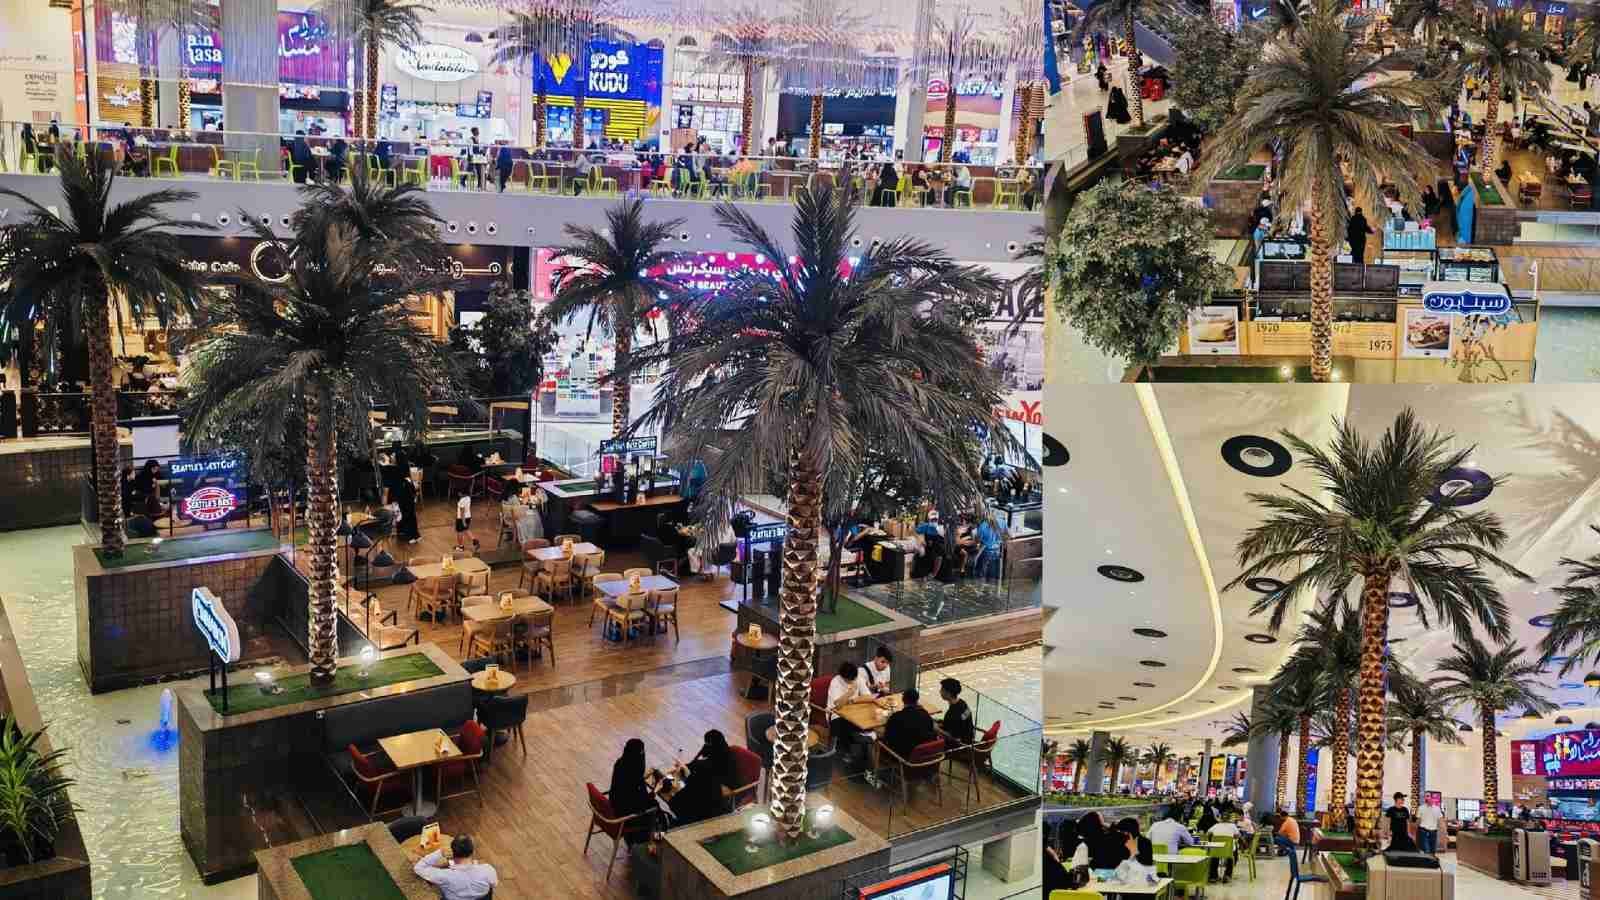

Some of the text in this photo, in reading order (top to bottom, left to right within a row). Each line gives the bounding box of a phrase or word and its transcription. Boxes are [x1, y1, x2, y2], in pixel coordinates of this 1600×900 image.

[590, 50, 629, 70] كودو
[589, 71, 628, 93] KUDU
[1255, 322, 1280, 333] 1970
[1368, 339, 1393, 353] 1975
